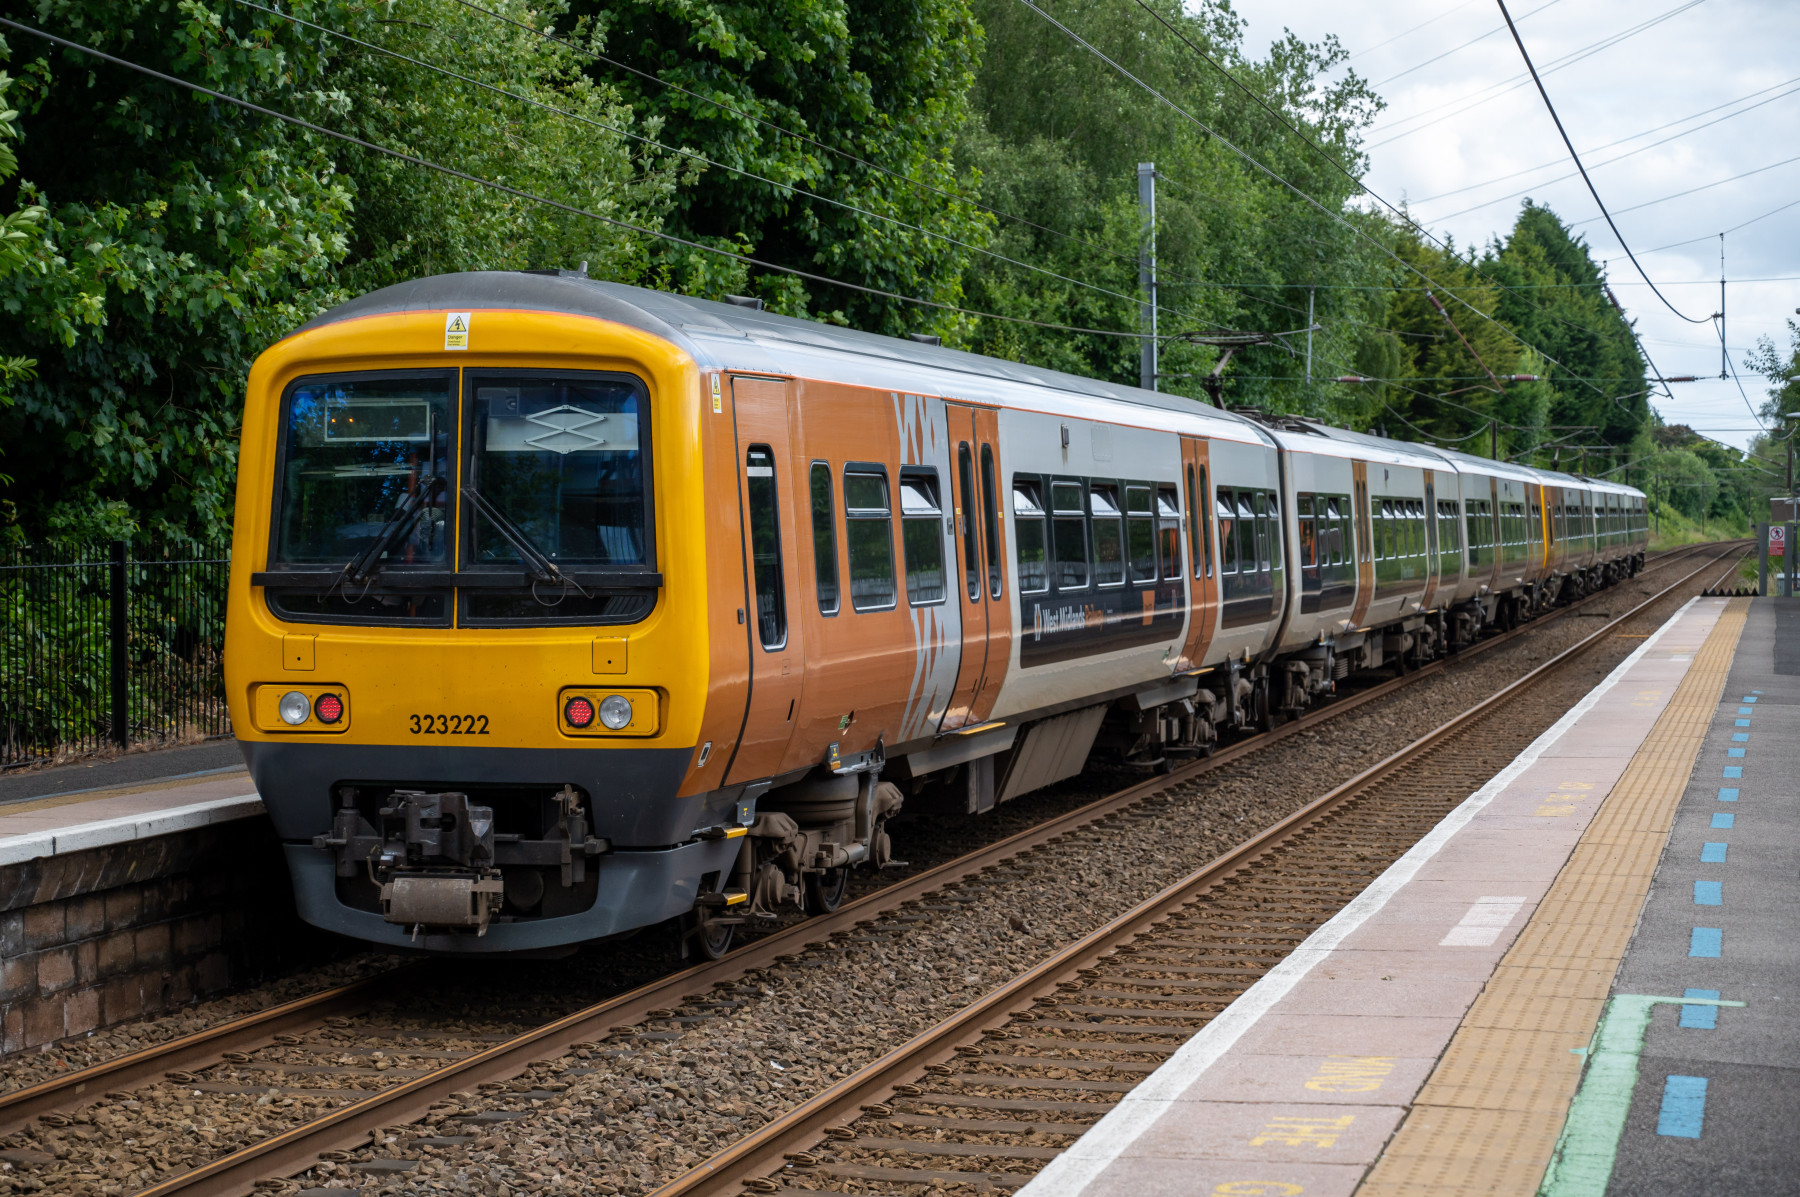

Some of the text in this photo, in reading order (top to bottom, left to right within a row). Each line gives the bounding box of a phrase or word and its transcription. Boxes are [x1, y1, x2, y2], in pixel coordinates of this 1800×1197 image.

[1043, 608, 1059, 634] West
[1060, 605, 1085, 632] Midlands
[409, 714, 490, 735] 323222
[1304, 1054, 1401, 1093] MIND
[1248, 1115, 1356, 1149] THE
